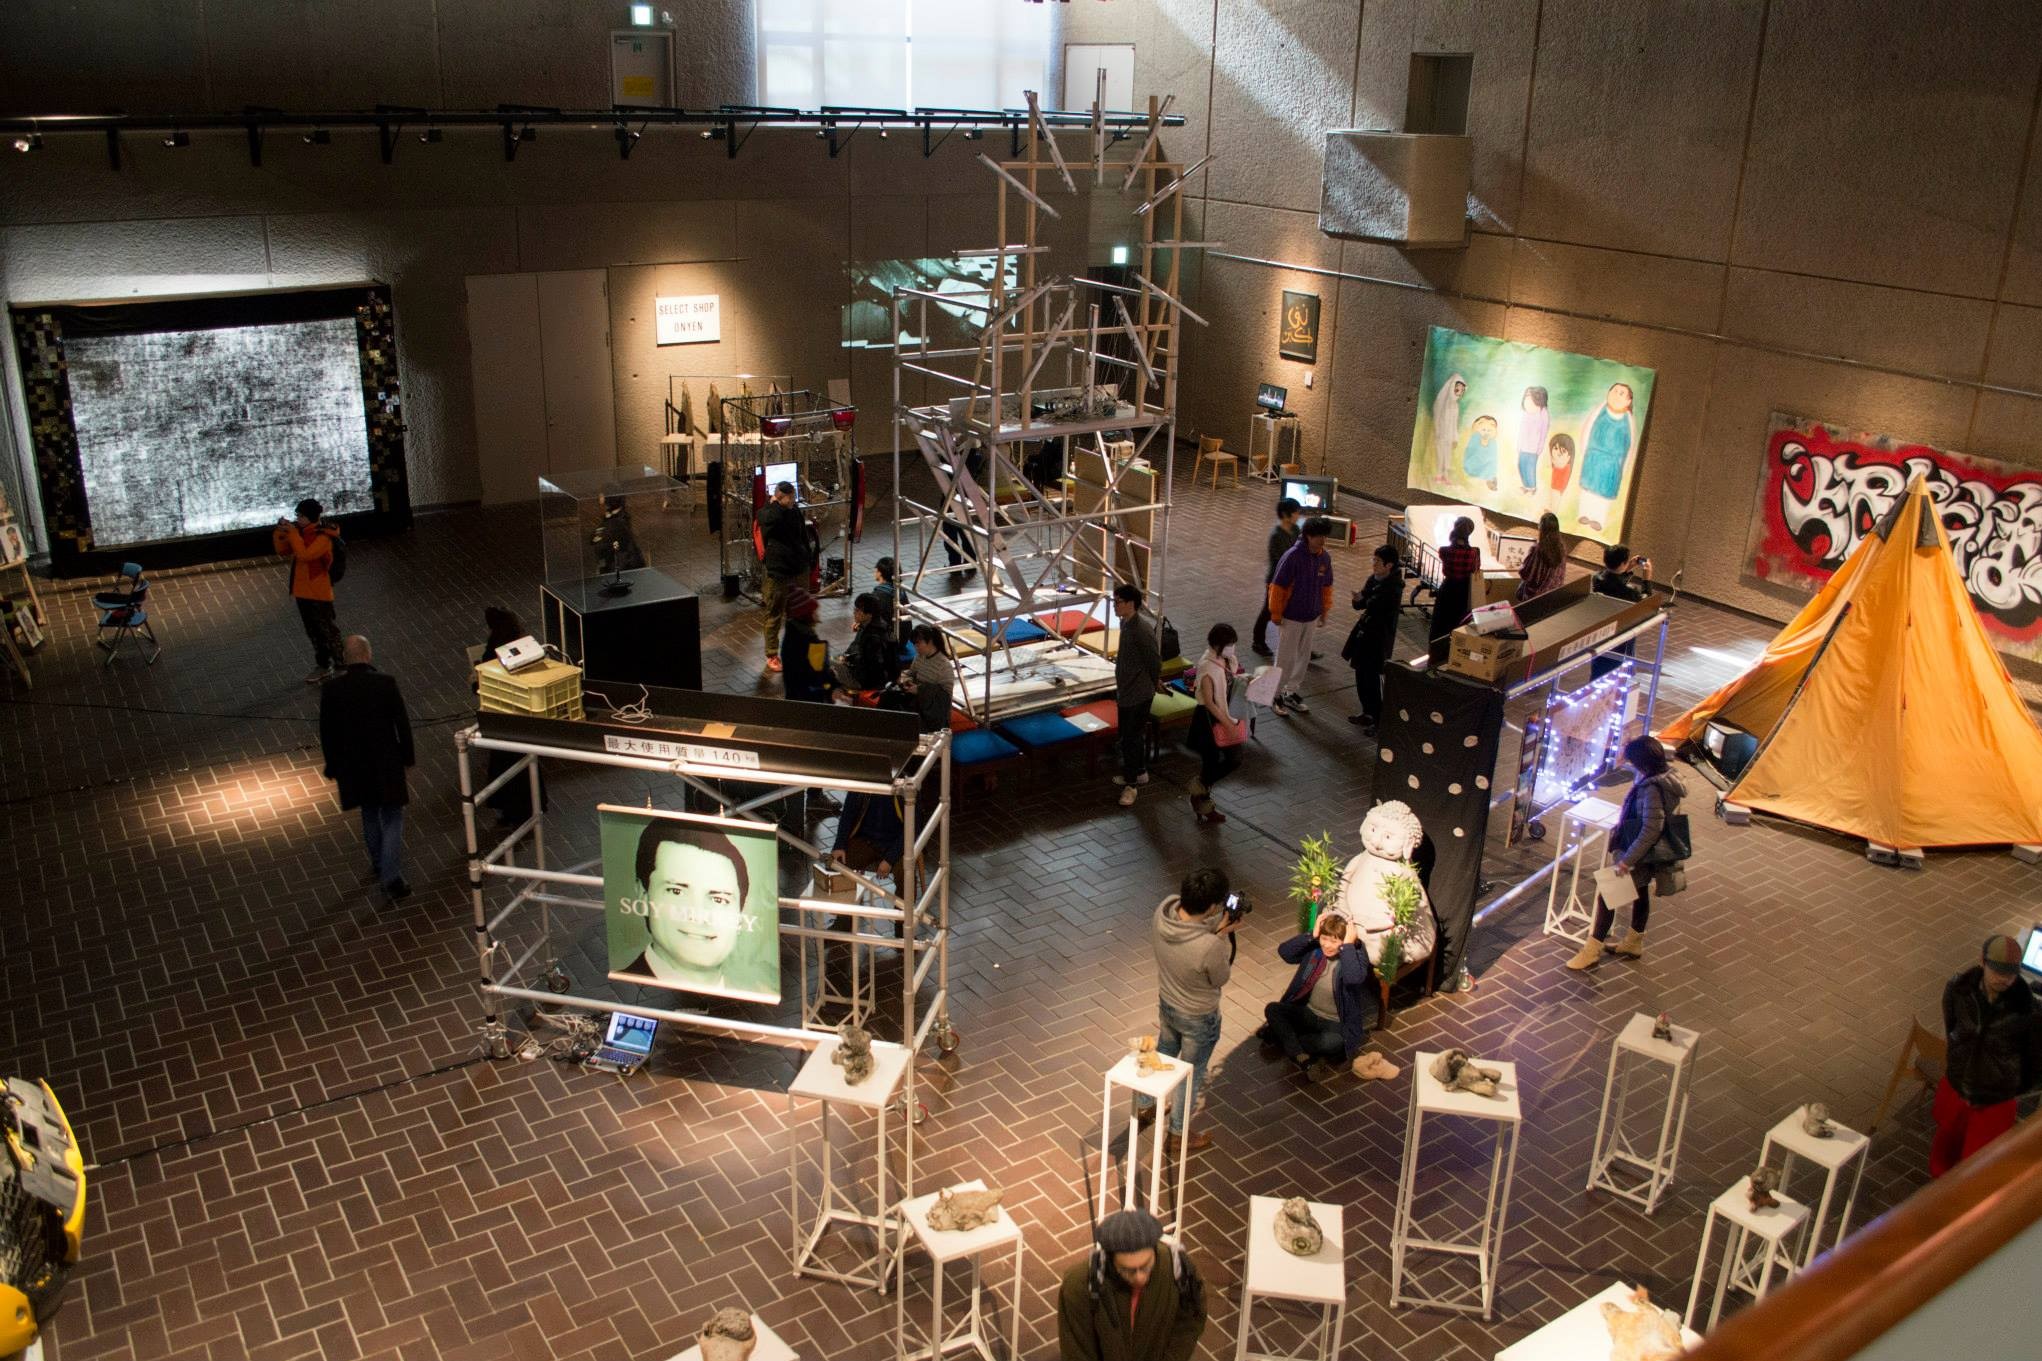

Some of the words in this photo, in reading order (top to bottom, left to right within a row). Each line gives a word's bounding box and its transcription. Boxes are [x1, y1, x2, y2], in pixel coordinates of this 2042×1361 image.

[658, 303, 689, 315] SELECT
[693, 302, 714, 313] SHOP
[674, 321, 703, 333] ONYEN
[619, 896, 664, 919] SOY
